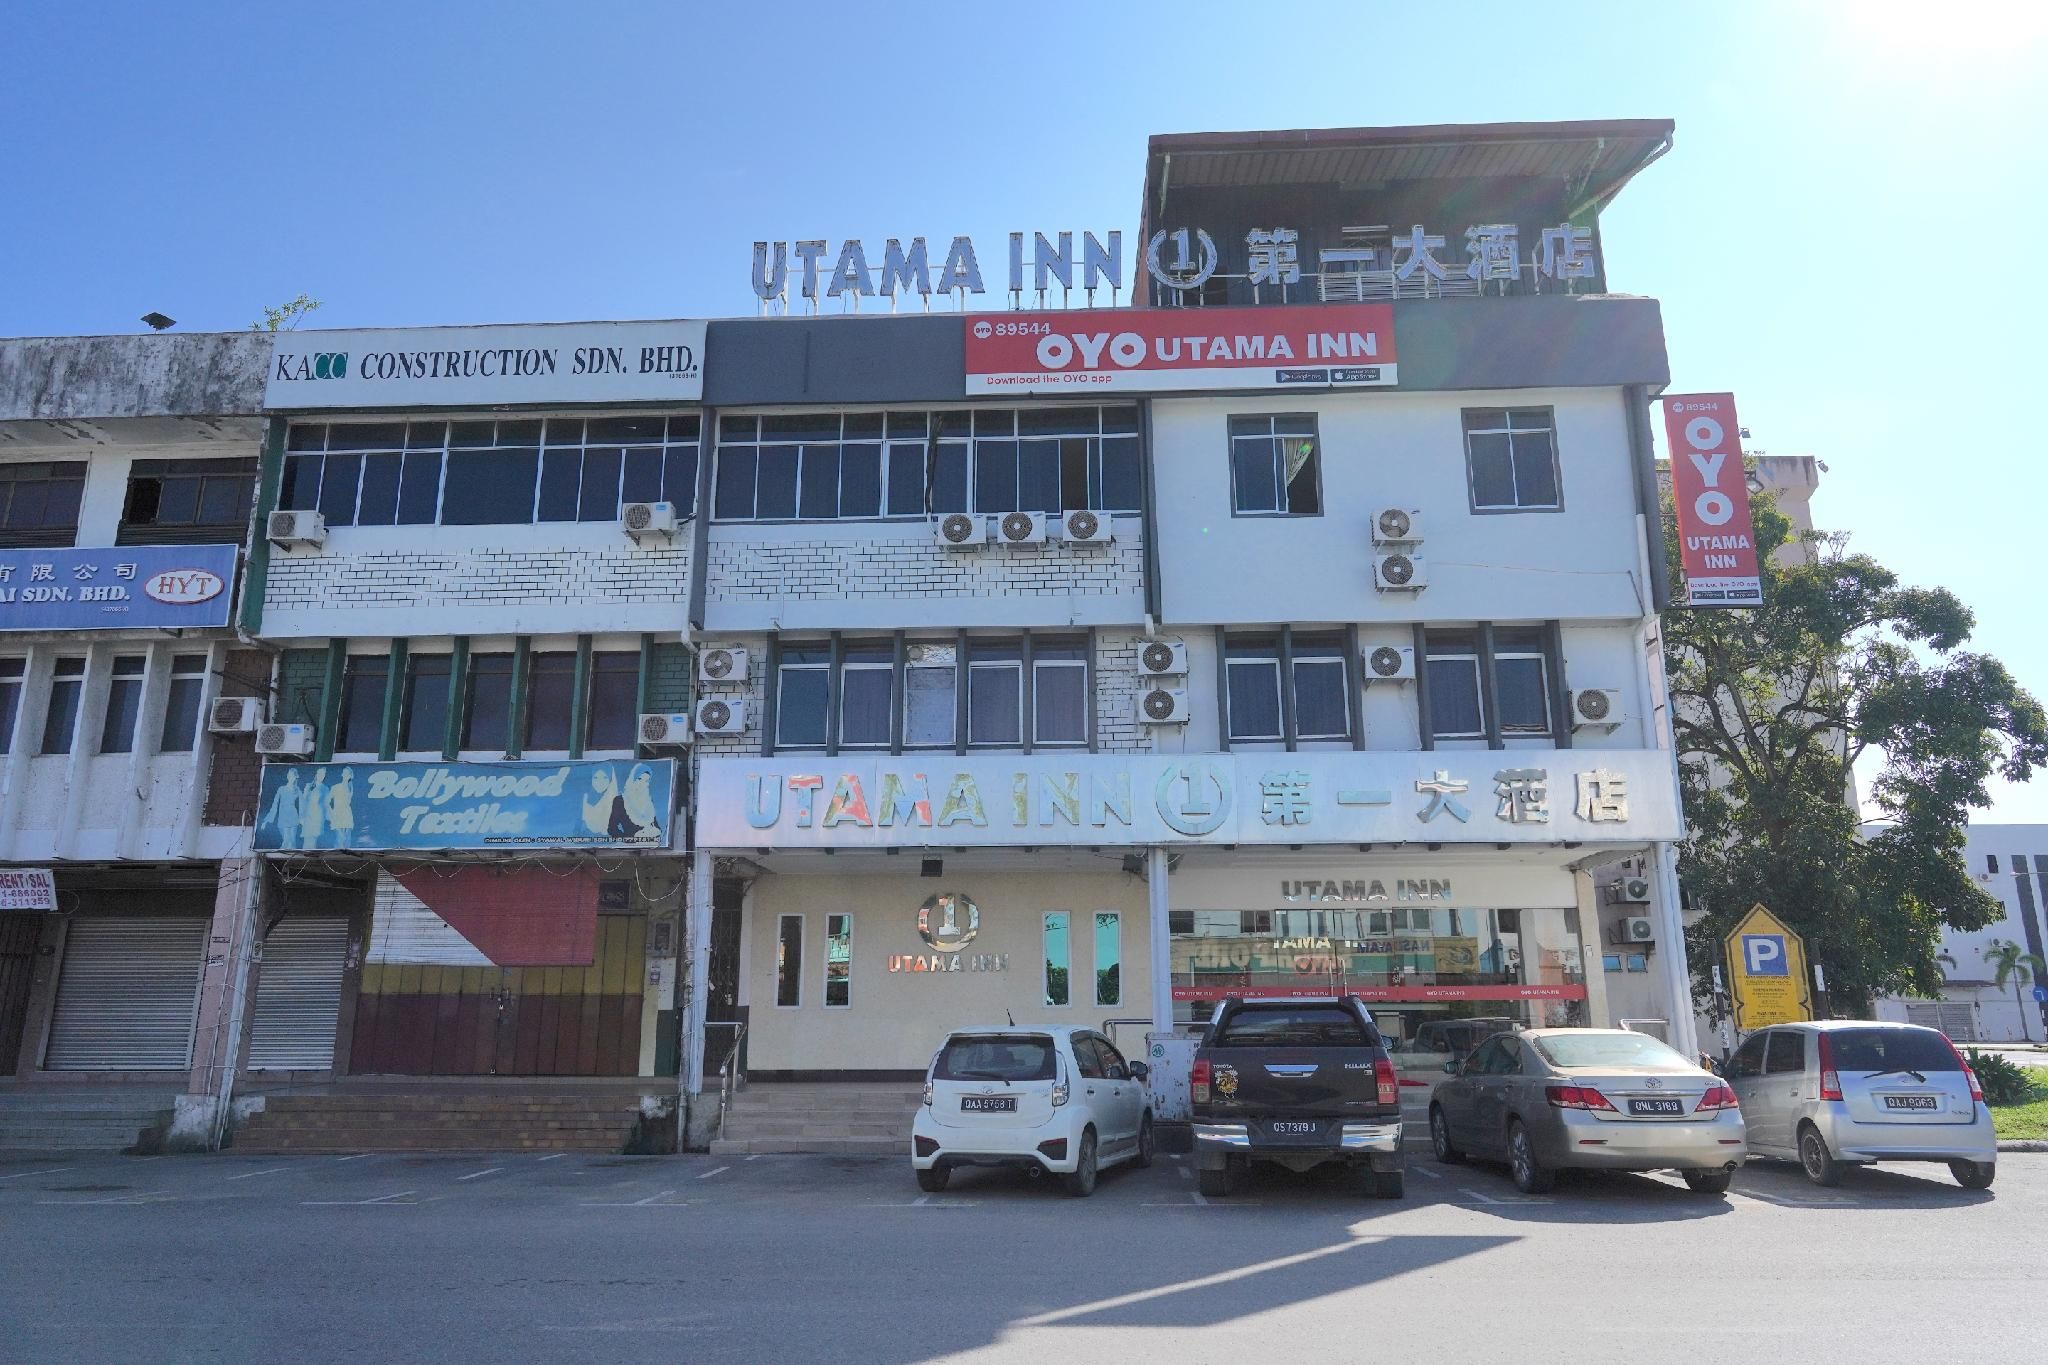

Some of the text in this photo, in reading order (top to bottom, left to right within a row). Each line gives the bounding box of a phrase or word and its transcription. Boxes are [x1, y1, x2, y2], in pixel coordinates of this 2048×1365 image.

[752, 231, 1122, 299] UTAMA INN
[1243, 223, 1595, 285] 第一大酒店
[995, 322, 1051, 336] 89544
[360, 349, 557, 379] CONSTRUCTION
[572, 347, 627, 374] SDN.
[638, 345, 698, 373] BHD.
[1036, 332, 1377, 369] OYO UTAMA INN
[987, 374, 1112, 385] Download the OYO app
[1685, 417, 1733, 525] OYO
[1687, 535, 1750, 550] UTAMA
[1704, 554, 1737, 569] INN
[21, 587, 73, 602] SDN.
[79, 585, 130, 600] BHD.
[158, 574, 212, 595] HYT
[368, 767, 571, 806] Bollywood
[745, 773, 1131, 828] UTAMA INN
[1259, 768, 1630, 825] 第一大酒店
[1281, 878, 1453, 901] UTAMA INN
[888, 954, 963, 973] UTAMA
[1748, 939, 1779, 972] P
